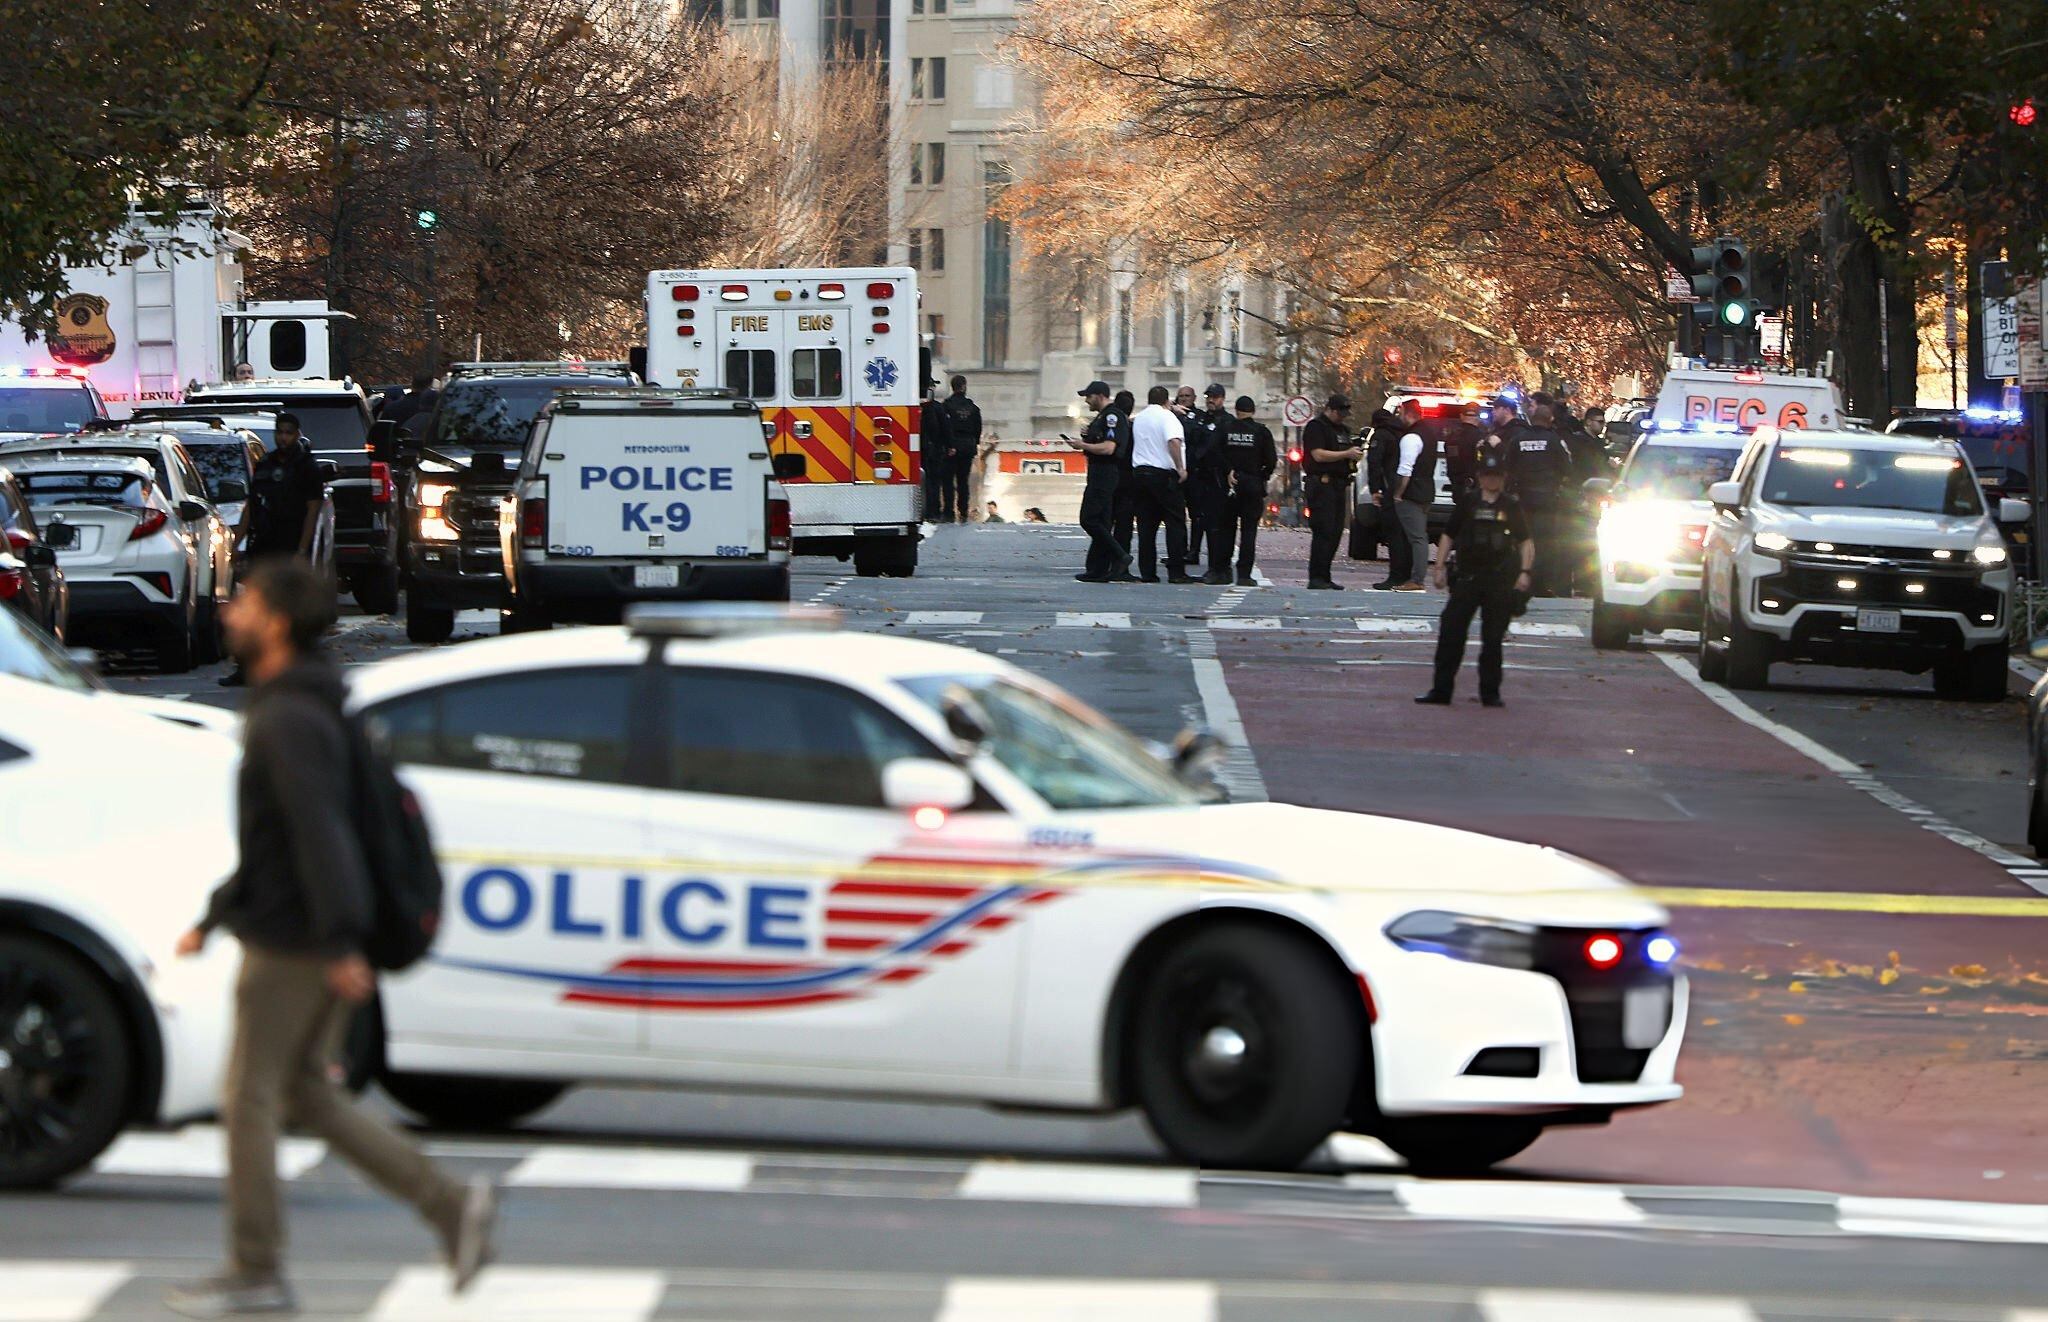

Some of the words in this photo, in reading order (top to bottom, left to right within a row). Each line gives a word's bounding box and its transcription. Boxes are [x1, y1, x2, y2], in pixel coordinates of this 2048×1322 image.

[731, 315, 769, 332] FIRE
[798, 314, 834, 331] EMS
[1778, 402, 1808, 430] 6
[624, 446, 690, 454] METROPOLITAN
[581, 466, 733, 491] POLICE
[622, 502, 692, 532] K-9
[716, 546, 748, 556] 8967
[461, 868, 809, 949] OLICE
